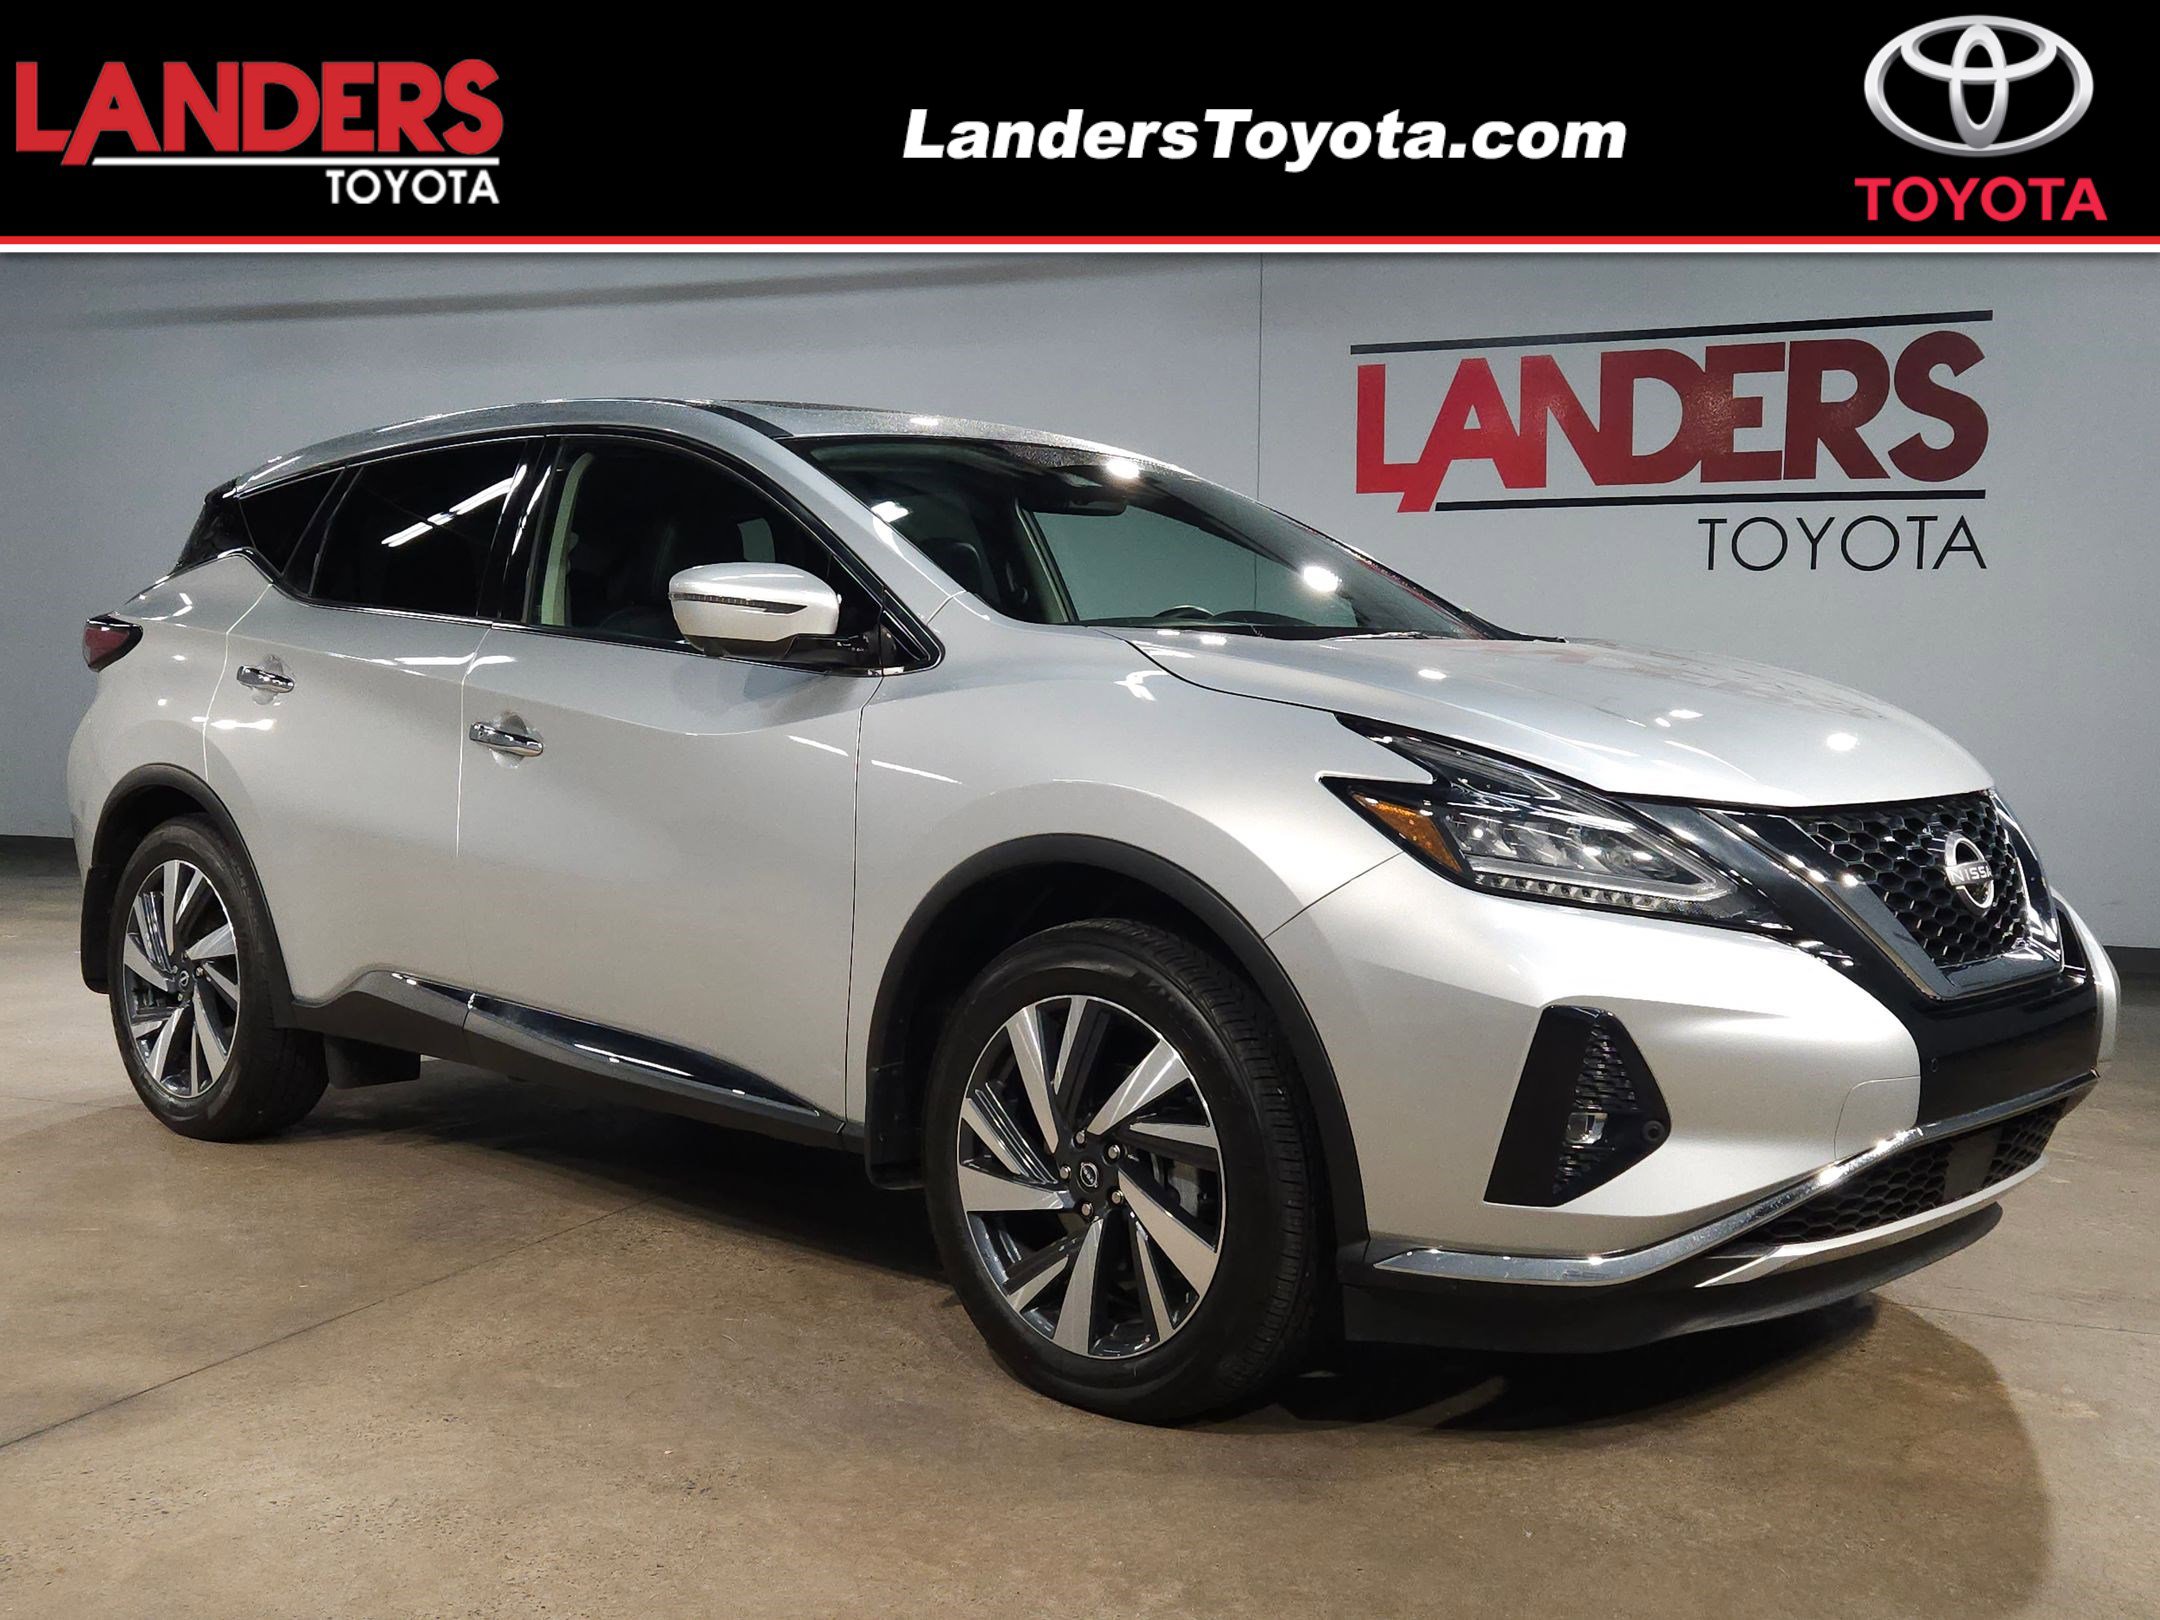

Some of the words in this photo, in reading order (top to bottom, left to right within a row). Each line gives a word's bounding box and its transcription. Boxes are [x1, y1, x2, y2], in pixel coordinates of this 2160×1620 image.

[1356, 331, 1989, 513] LANDERS
[1698, 515, 1987, 572] TOYOTA
[1951, 865, 1993, 883] NISSA
